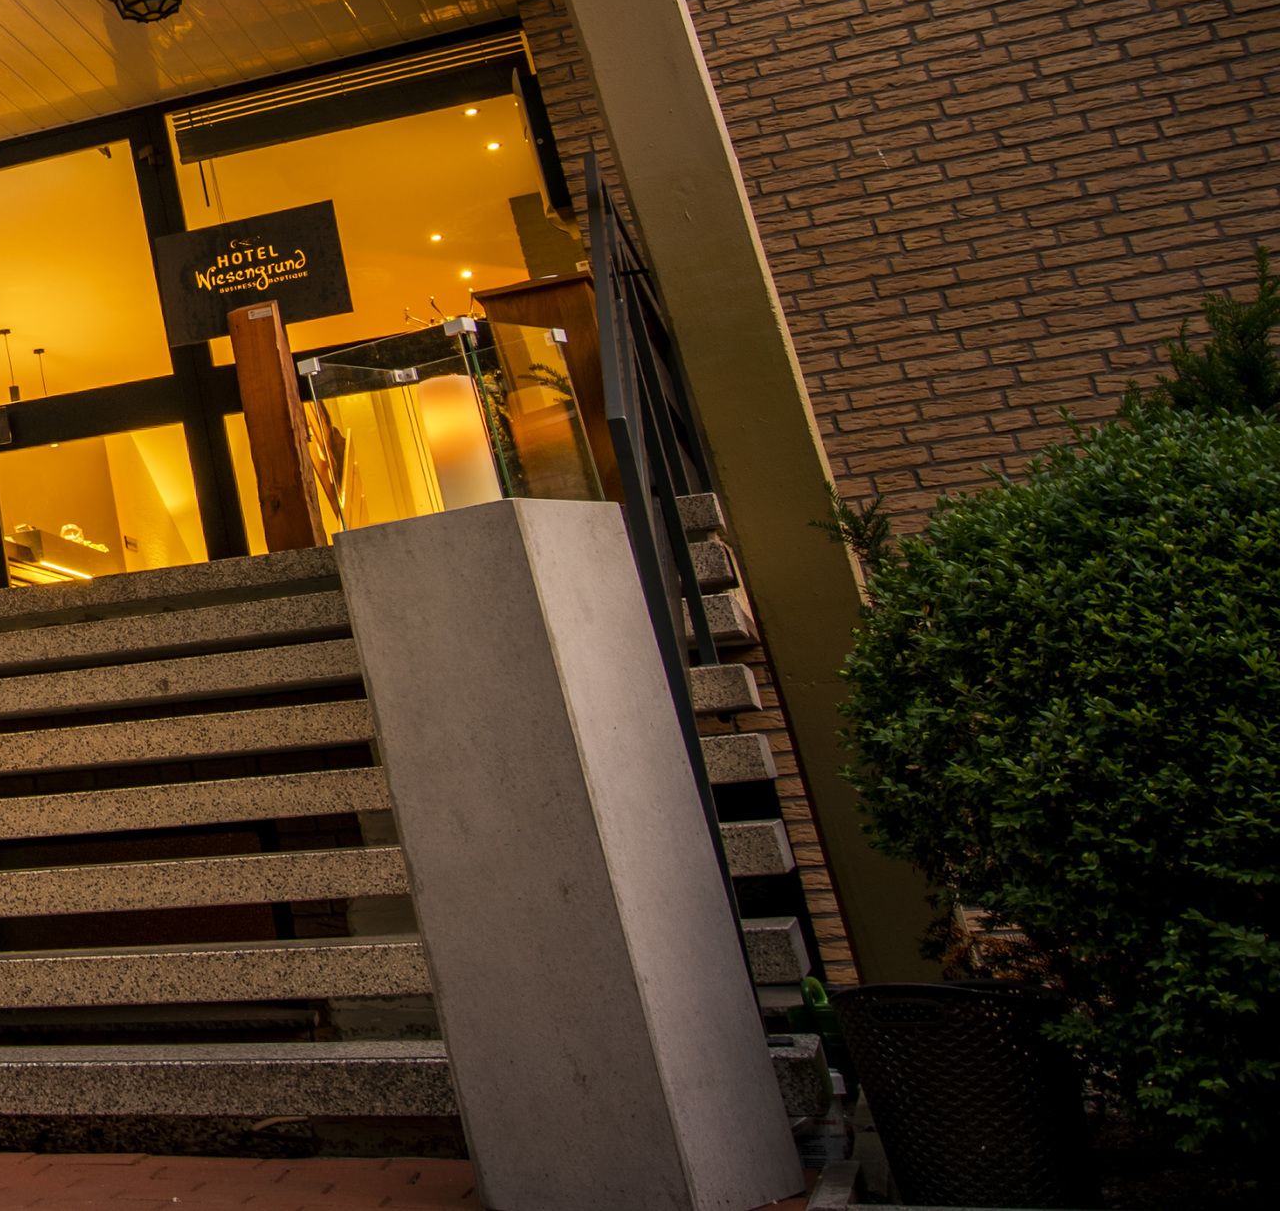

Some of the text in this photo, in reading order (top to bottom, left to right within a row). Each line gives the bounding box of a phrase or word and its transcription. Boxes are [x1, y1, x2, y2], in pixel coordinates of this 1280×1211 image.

[217, 245, 279, 268] HOTEL
[195, 249, 306, 291] Wiesengrund
[219, 281, 257, 294] BUSINESS
